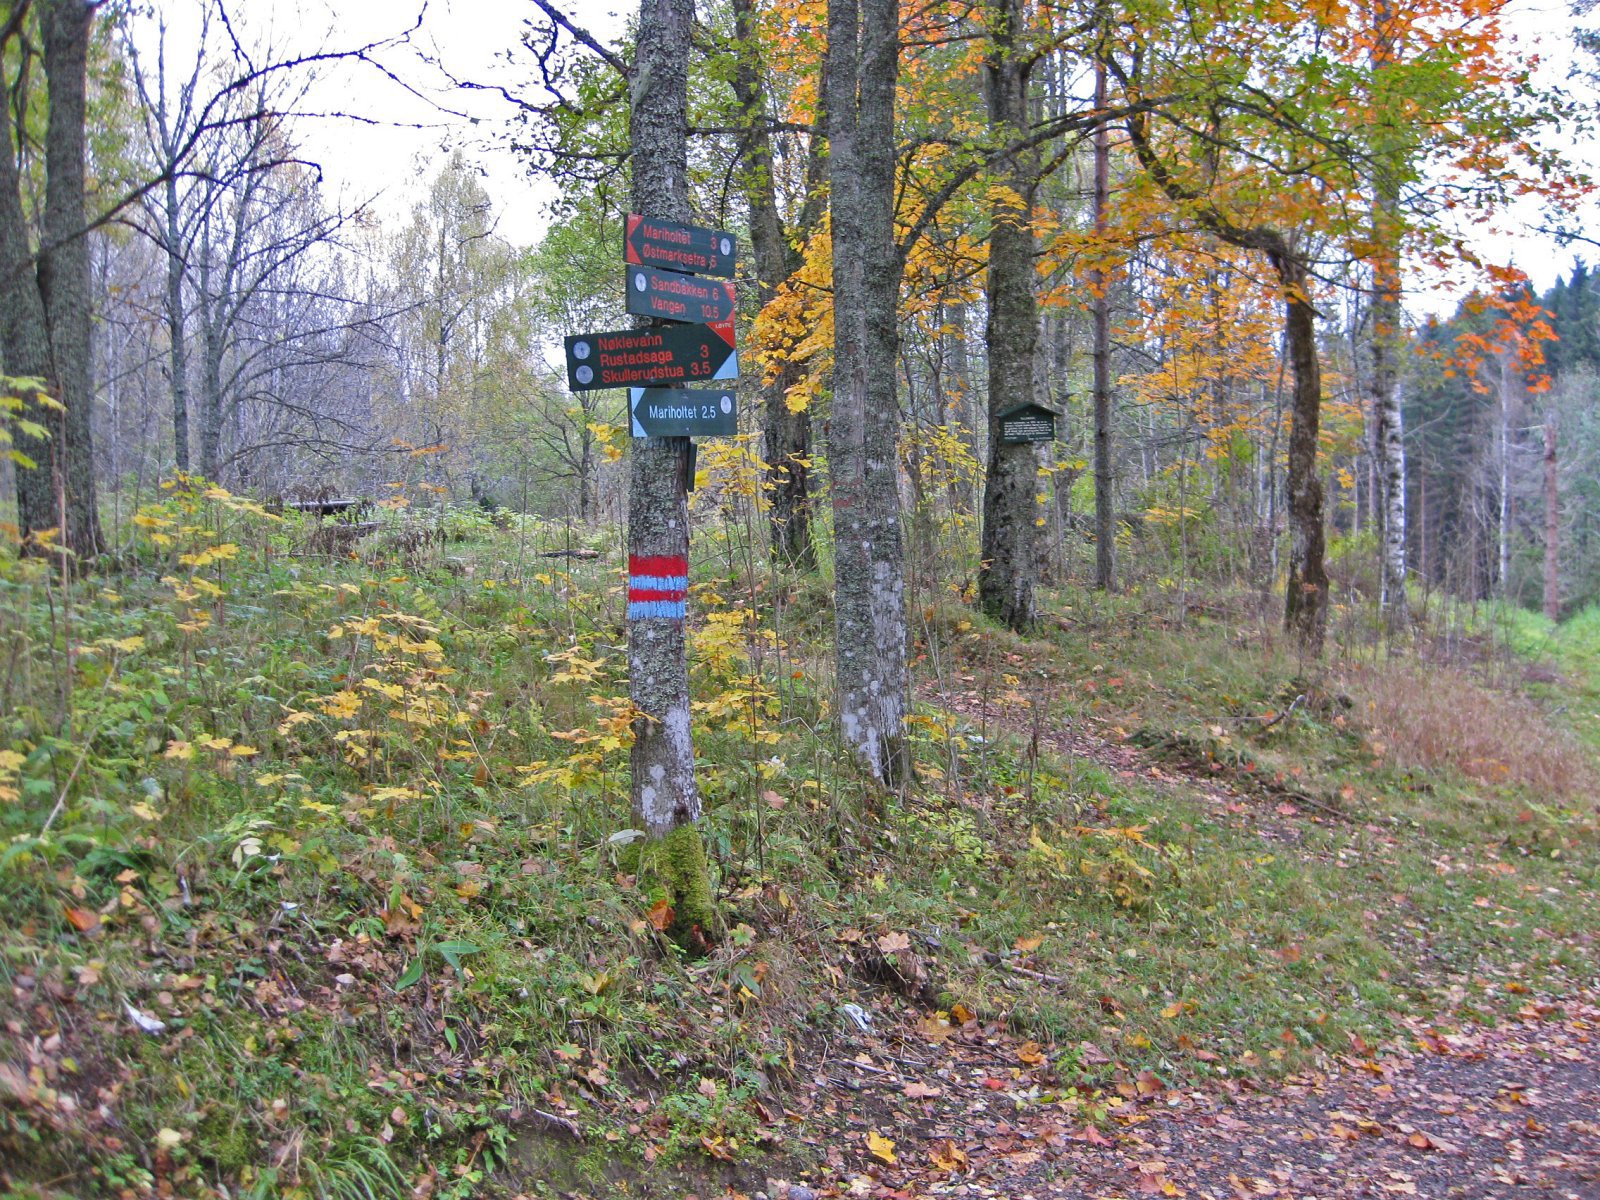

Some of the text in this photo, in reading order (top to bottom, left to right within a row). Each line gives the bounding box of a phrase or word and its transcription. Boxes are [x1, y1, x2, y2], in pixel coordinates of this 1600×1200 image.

[644, 225, 717, 250] Mariholtet 3
[643, 243, 706, 266] Østmarksetra
[651, 276, 719, 300] Sandbakken 6
[651, 296, 719, 319] Vangen 10.5
[598, 335, 662, 350] Nøklevann
[600, 344, 709, 366] Rustadsaga 3
[603, 361, 711, 383] Skullerudstua 3.5
[649, 405, 716, 419] Mariholtet 2.5
